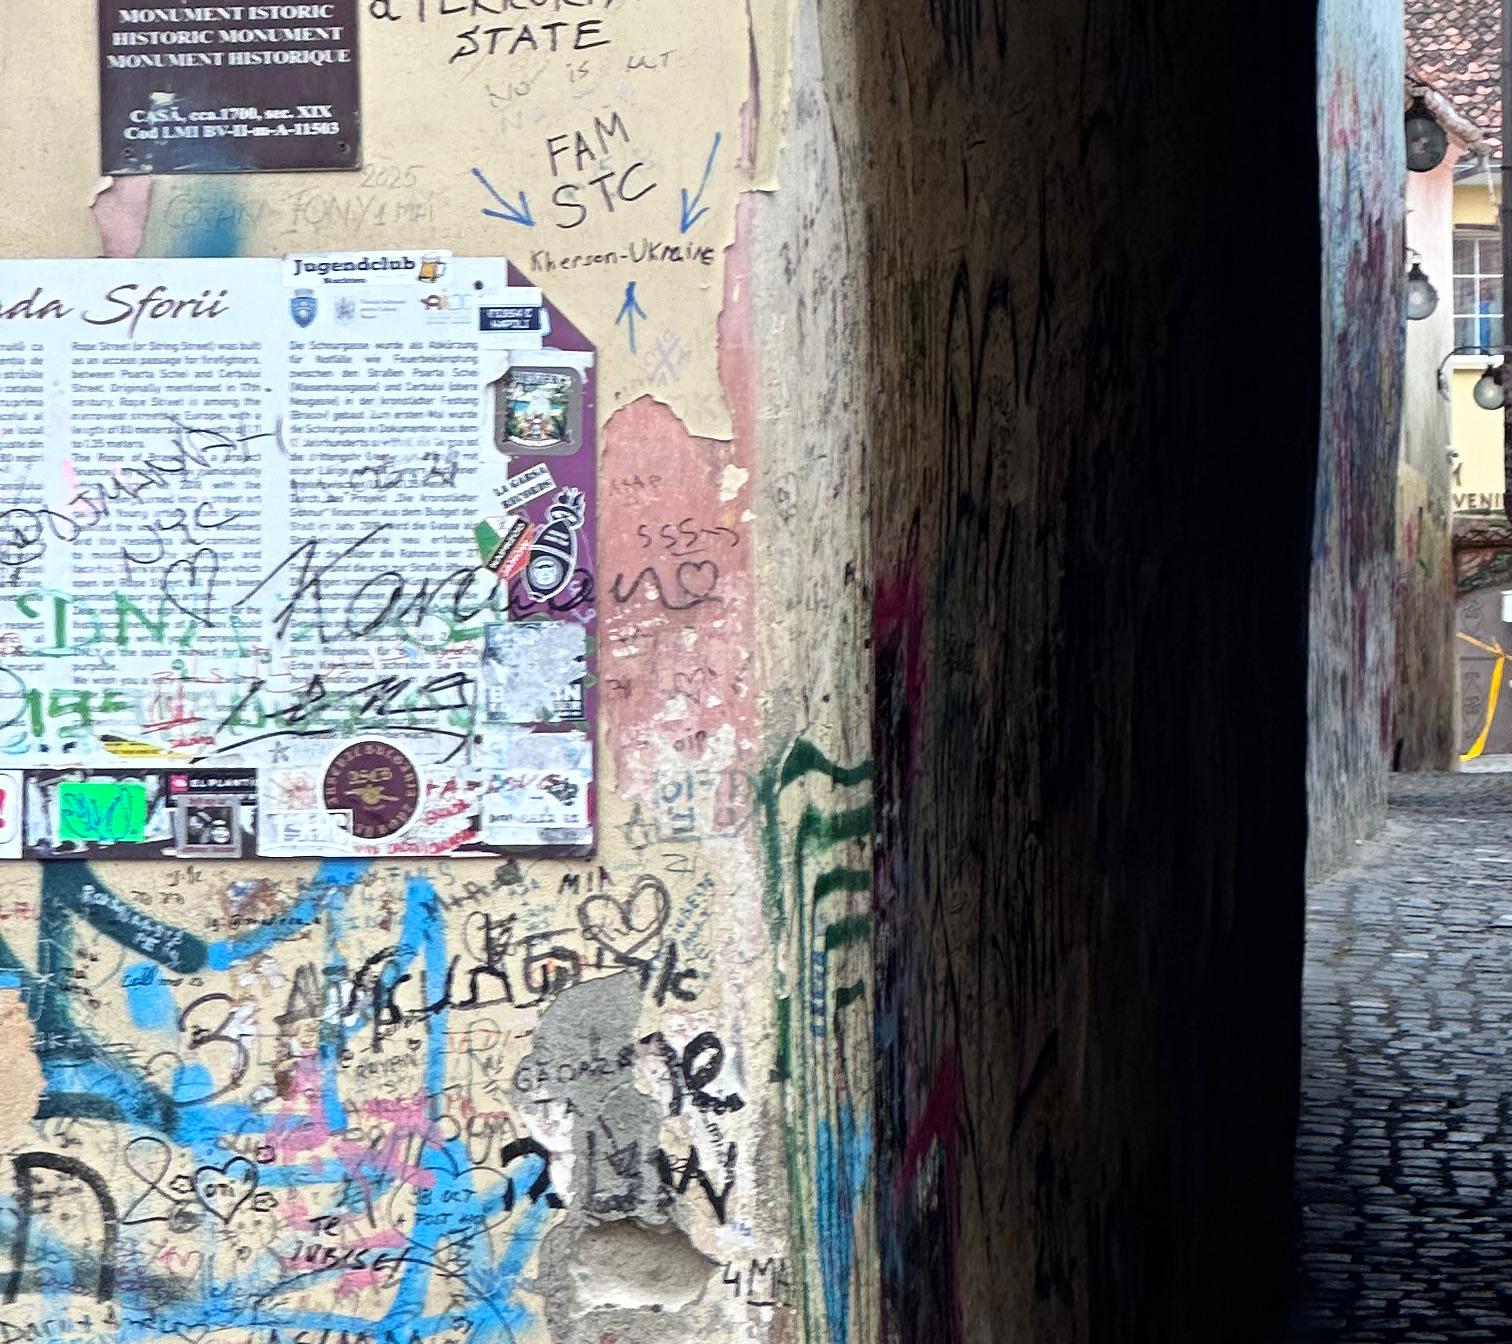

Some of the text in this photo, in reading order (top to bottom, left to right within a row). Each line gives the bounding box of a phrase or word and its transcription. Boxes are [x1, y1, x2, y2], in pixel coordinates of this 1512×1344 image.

[119, 4, 335, 24] MONUMENT ISTORIC
[112, 27, 344, 46] HISTORIC MONUMENT
[449, 19, 612, 64] STATE
[106, 49, 352, 68] MONUMENT HISTORIQUE
[296, 105, 333, 119] XIX
[124, 126, 159, 140] Cod
[162, 125, 199, 139] LMI
[546, 111, 632, 177] FAM
[552, 162, 657, 229] STC
[293, 257, 416, 275] Jugendclub
[0, 283, 231, 339] da Sforii
